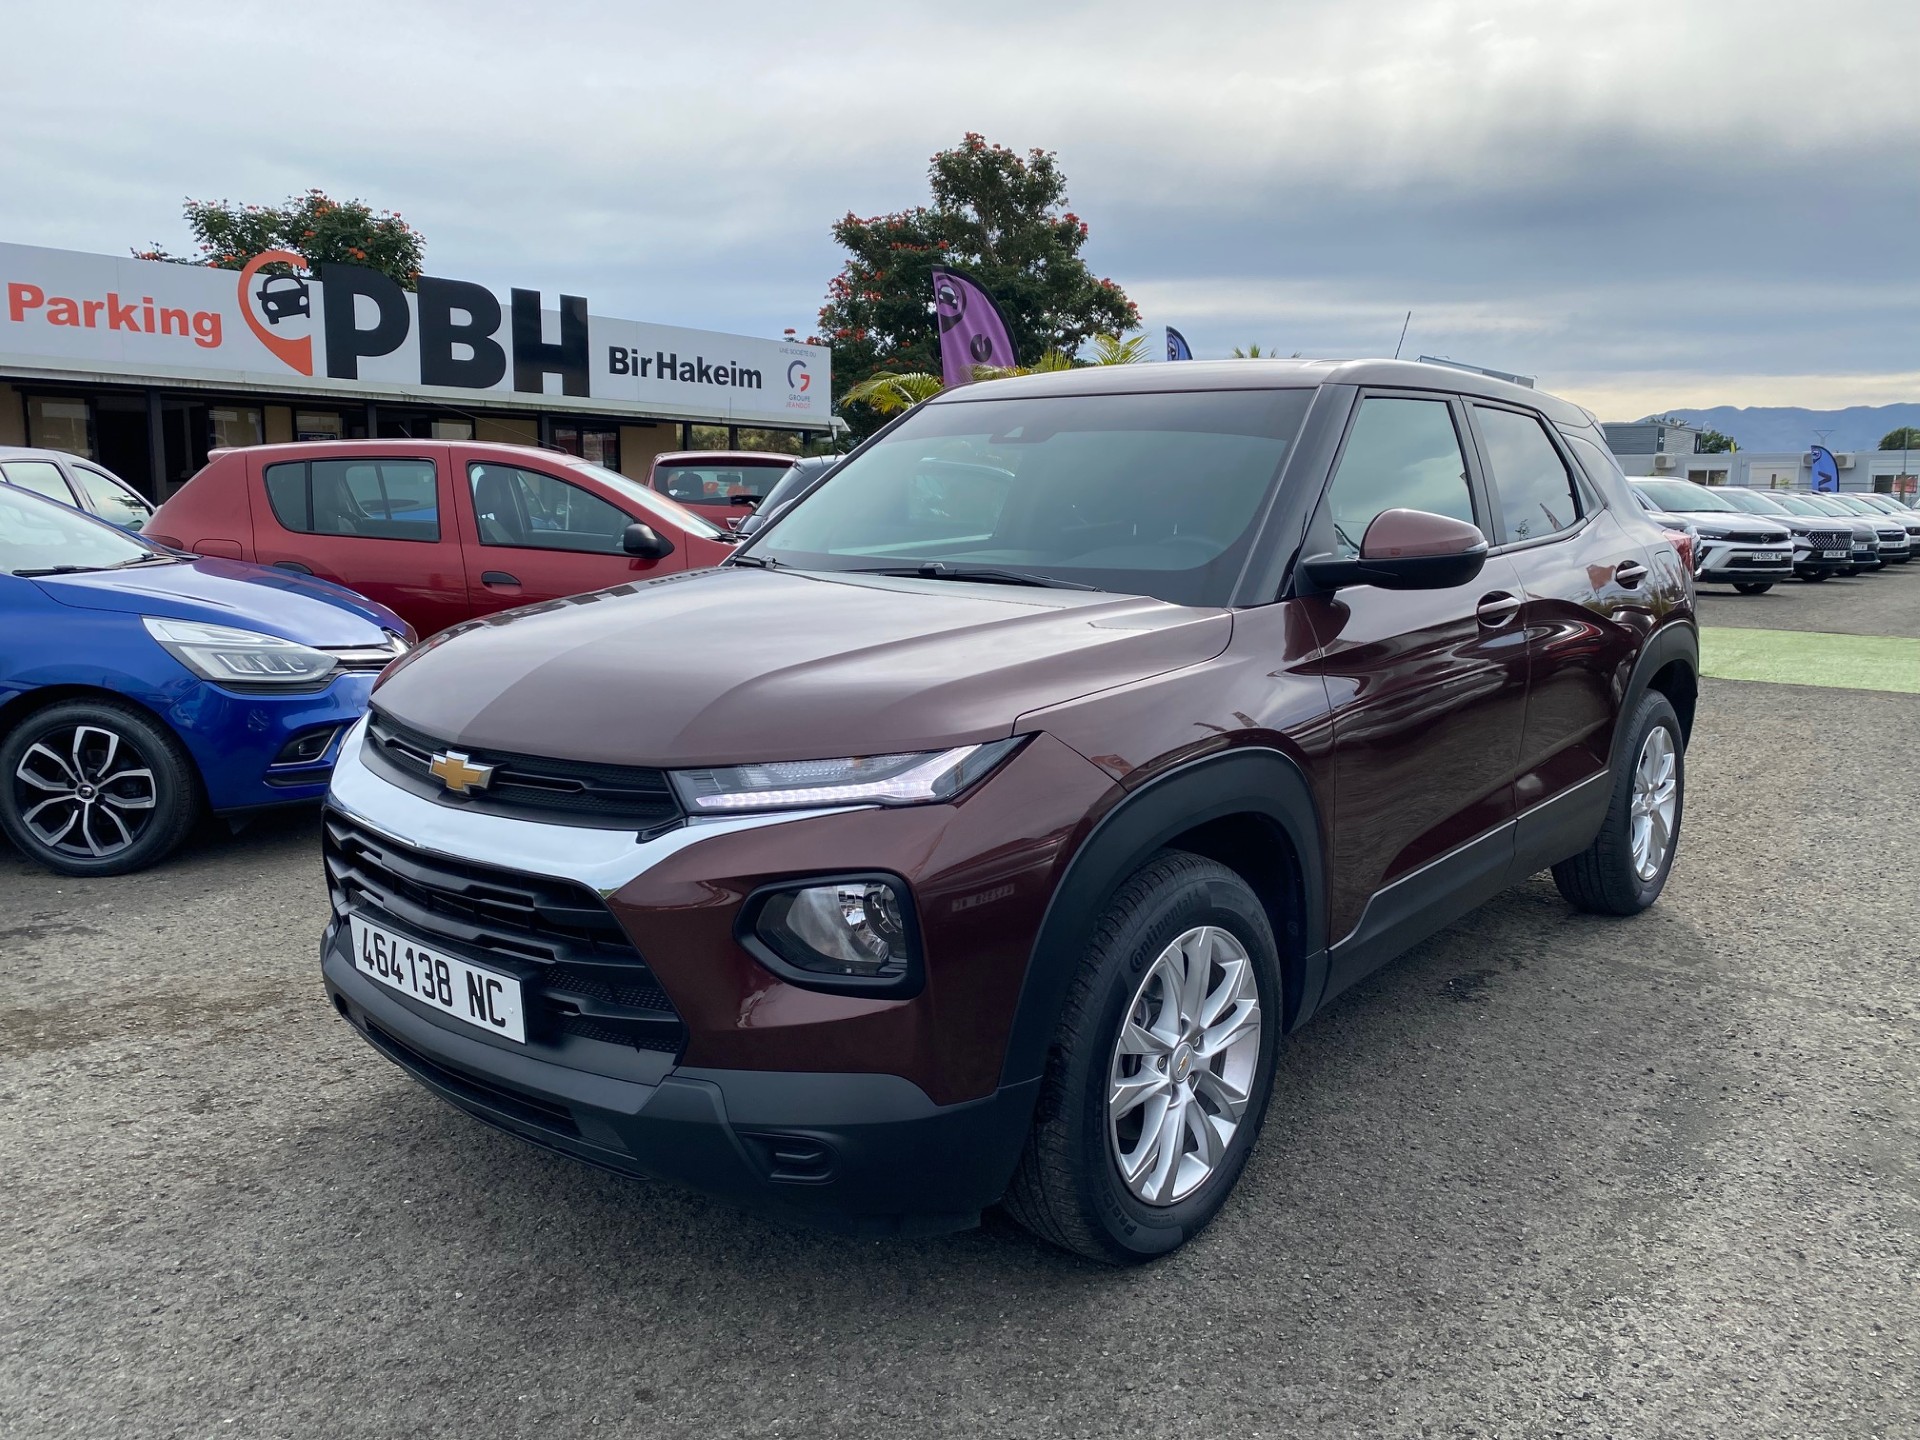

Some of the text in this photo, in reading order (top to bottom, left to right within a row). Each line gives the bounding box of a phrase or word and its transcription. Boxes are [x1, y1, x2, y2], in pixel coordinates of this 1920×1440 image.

[8, 282, 223, 348] Parking
[321, 263, 590, 398] PBH
[788, 394, 810, 402] GROUPE
[1130, 892, 1192, 973] Continental
[363, 927, 506, 1028] 464138 NC
